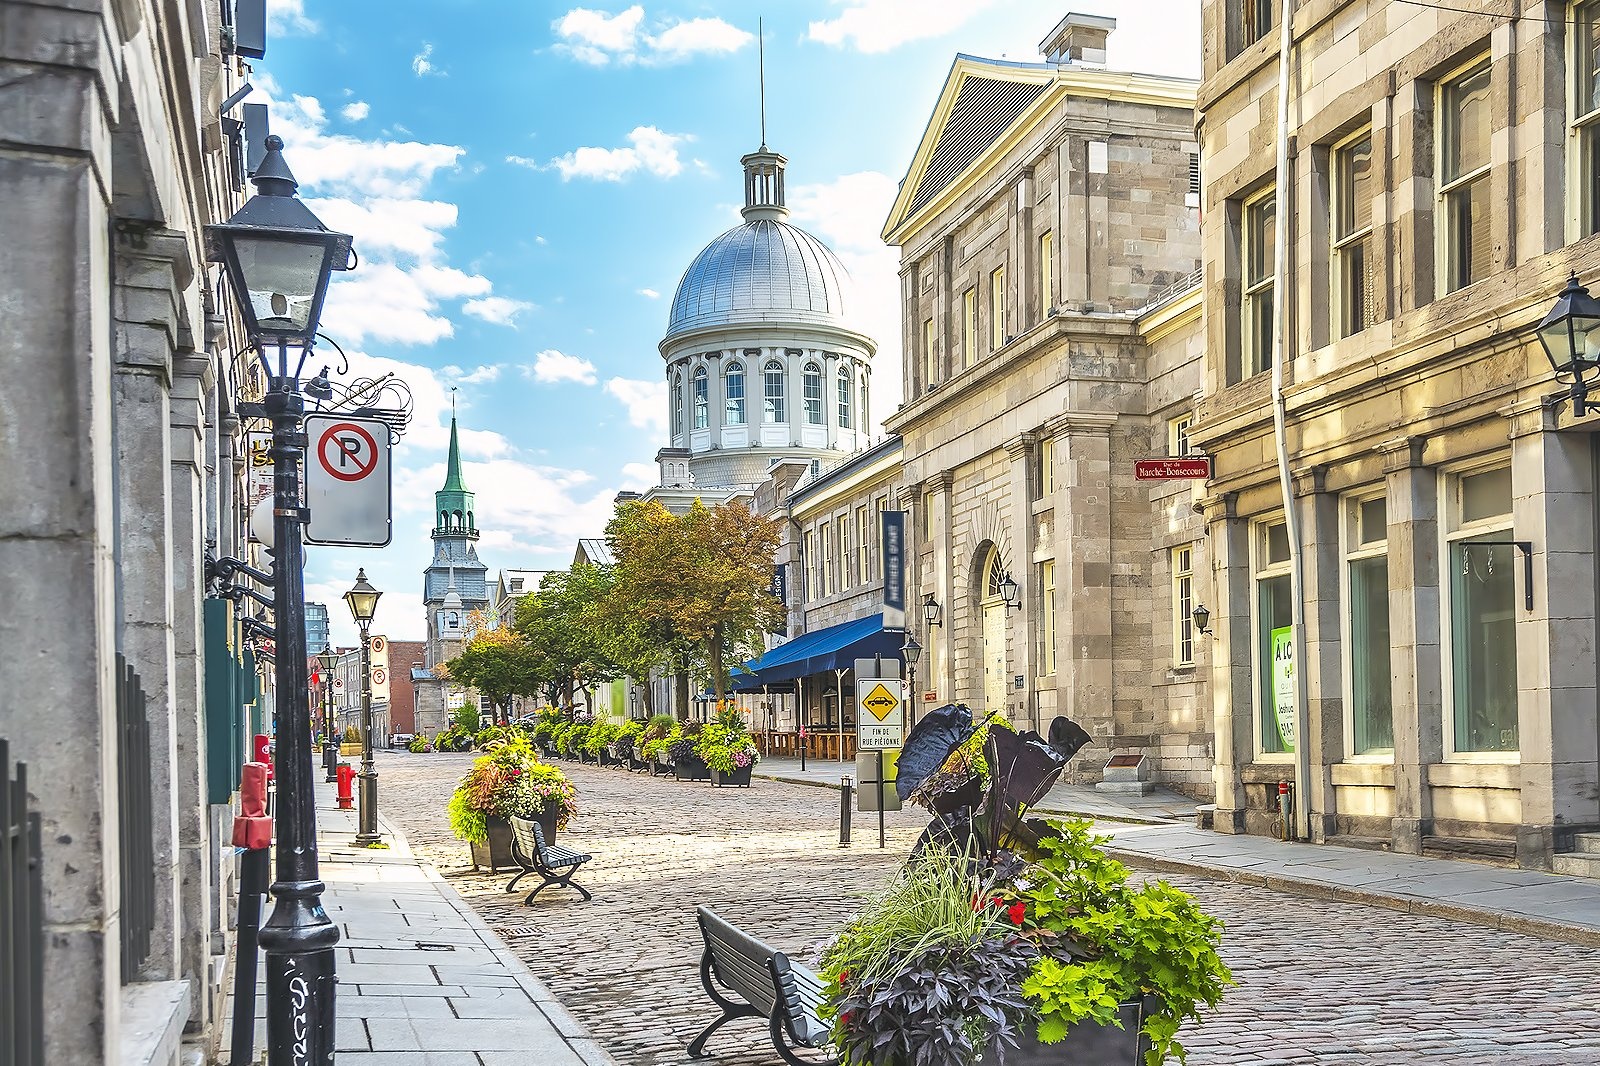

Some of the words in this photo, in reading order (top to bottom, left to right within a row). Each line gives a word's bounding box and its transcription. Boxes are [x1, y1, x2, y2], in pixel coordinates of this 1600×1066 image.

[1139, 467, 1205, 477] Marché-Bonsecours
[872, 728, 882, 736] FIN
[883, 728, 890, 736] DE
[862, 738, 873, 746] RUE
